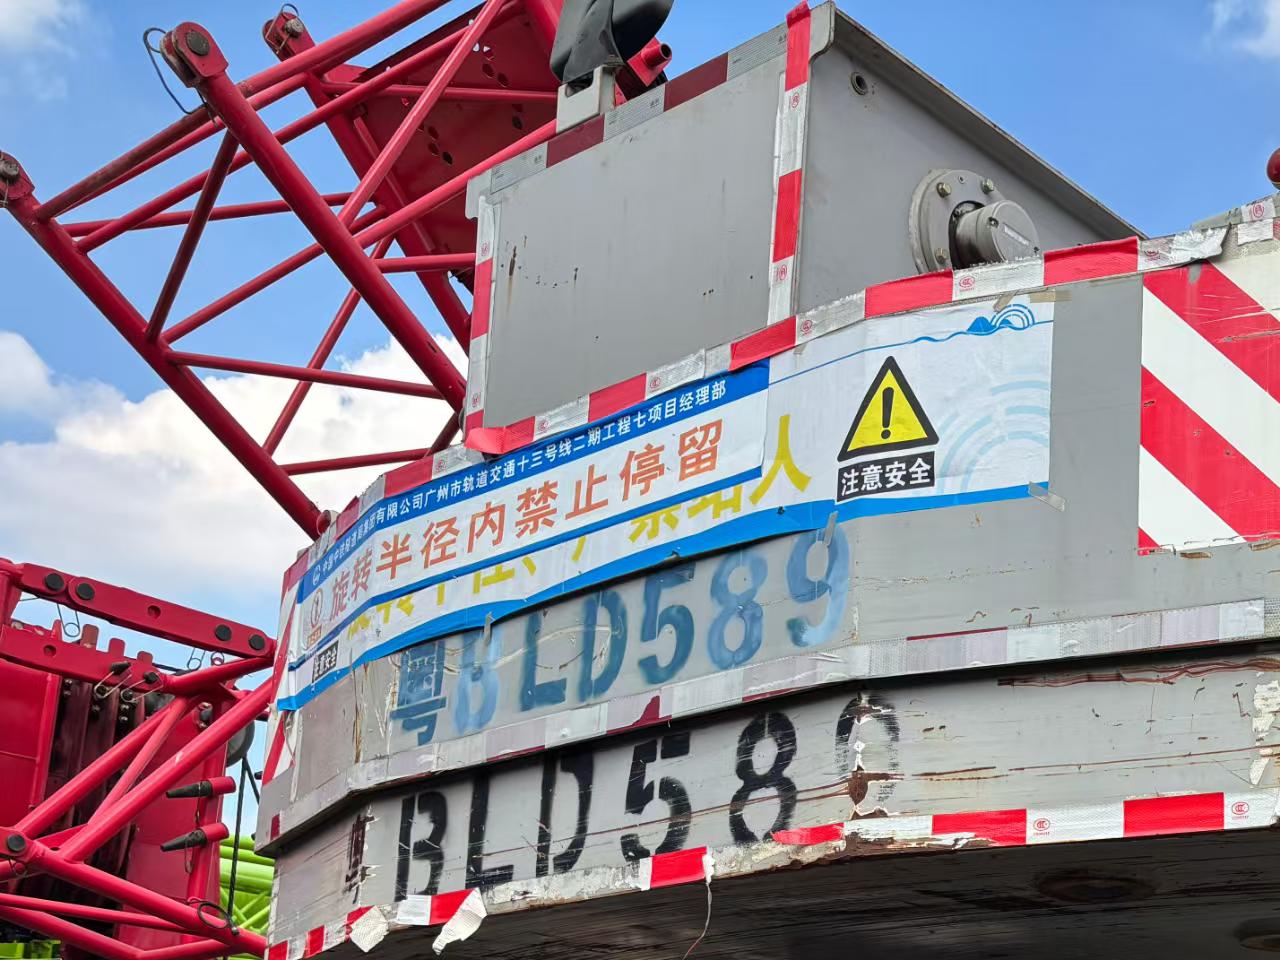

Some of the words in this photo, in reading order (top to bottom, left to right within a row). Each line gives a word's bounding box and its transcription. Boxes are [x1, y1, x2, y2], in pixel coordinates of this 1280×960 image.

[329, 418, 723, 622] 旋转半径内禁止停留
[841, 460, 932, 496] 注意安全
